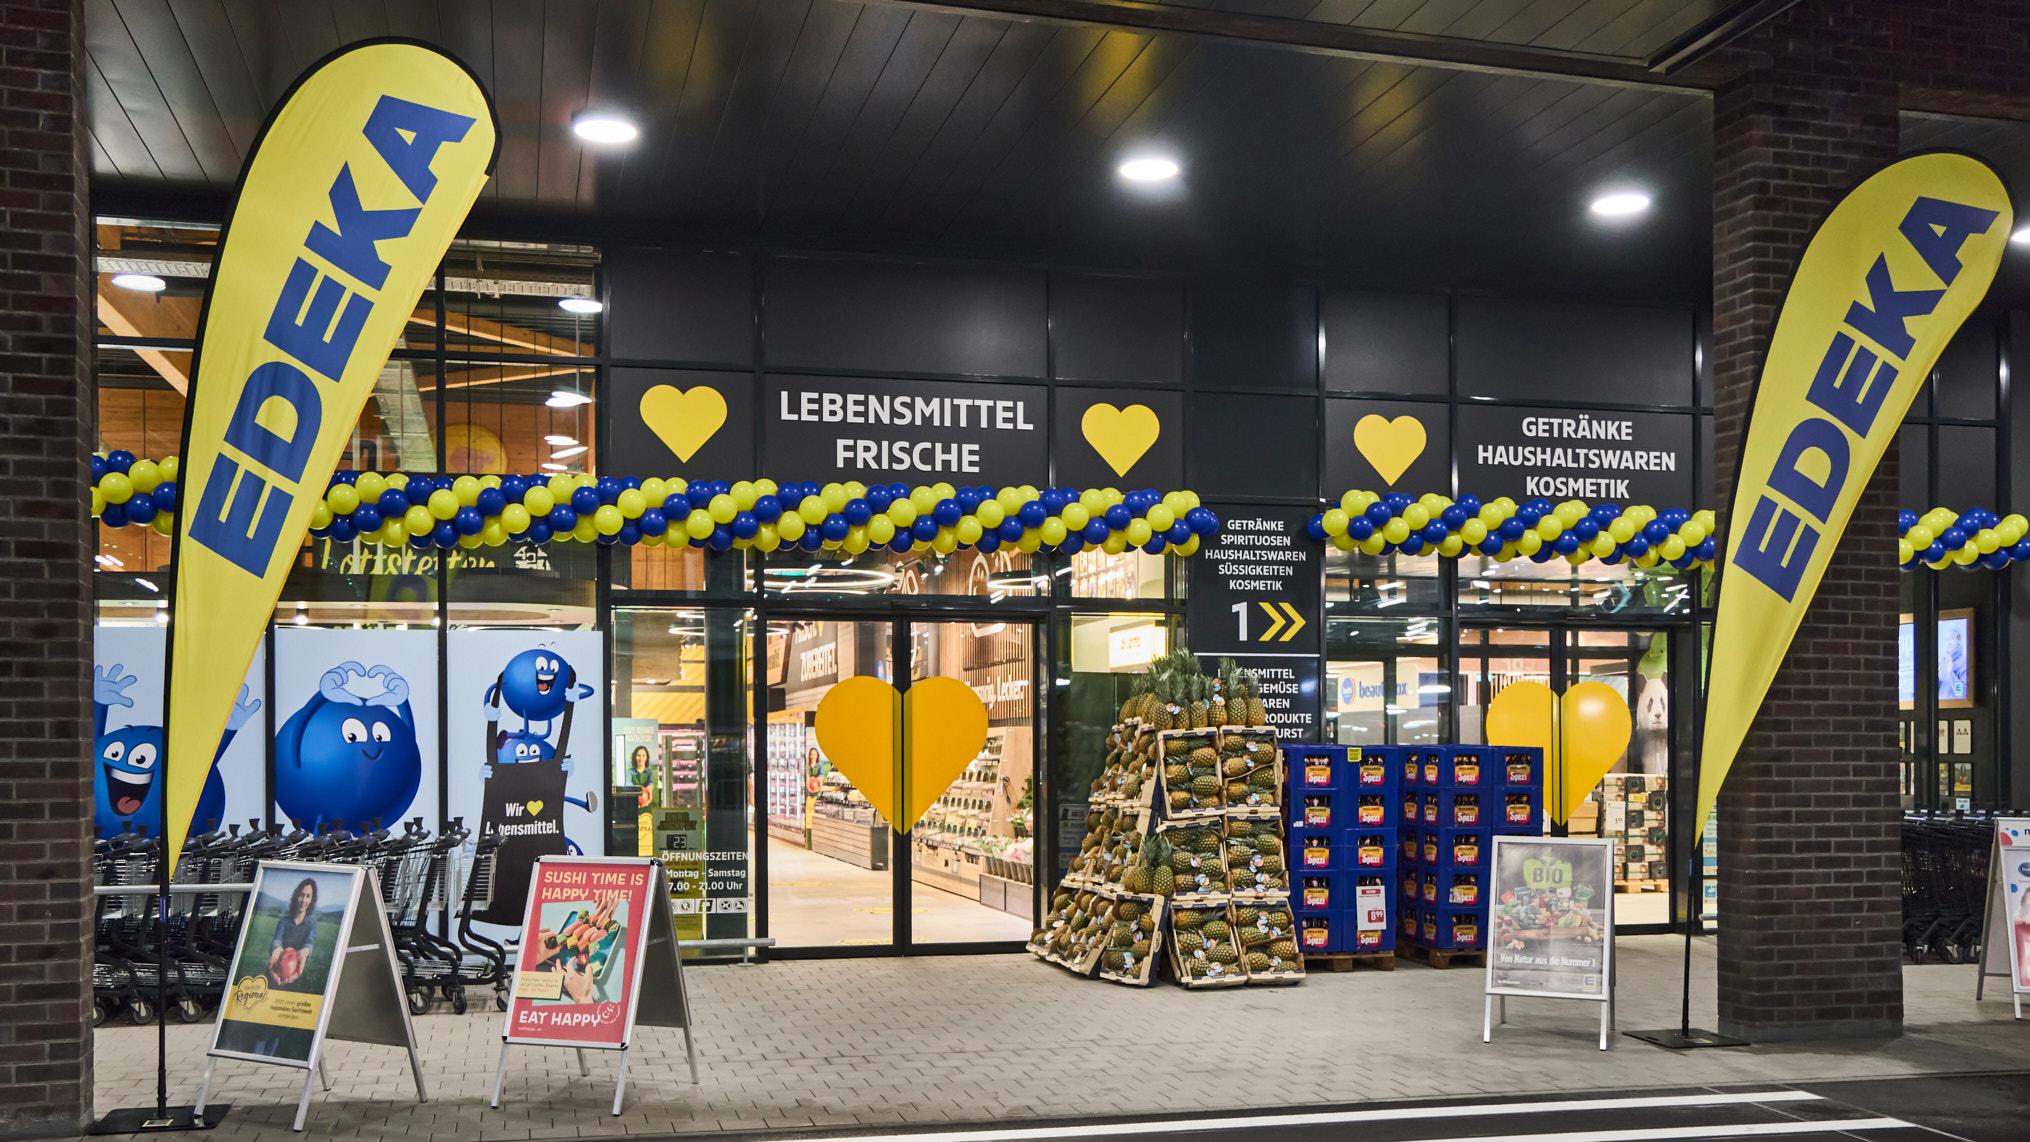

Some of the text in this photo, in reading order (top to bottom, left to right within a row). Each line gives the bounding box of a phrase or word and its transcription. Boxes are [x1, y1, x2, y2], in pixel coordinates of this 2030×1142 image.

[189, 95, 477, 578] EDEKA
[1733, 196, 2000, 603] EDEKA
[780, 390, 1034, 430] LEBENSMITTEL
[1521, 414, 1633, 441] GETRÄNKE
[836, 438, 980, 473] FRISCHE
[1477, 444, 1676, 472] HAUSHALTSWAREN
[1526, 476, 1630, 499] KOSMETIK
[1227, 518, 1285, 531] GETRÄNKE
[1220, 534, 1291, 546] SPIRITUOSEN
[1205, 548, 1307, 561] HAUSHALTSWAREN
[1218, 562, 1294, 576] SÜSSIGKEITEN
[1229, 579, 1283, 591] KOSMETIK
[1231, 601, 1248, 642] 1
[1260, 698, 1290, 709] AREN
[1264, 713, 1313, 724] RODUKTE
[1275, 728, 1304, 739] URST
[505, 802, 525, 817] Wir
[673, 835, 687, 848] 23
[661, 850, 749, 861] ÖFFNUNGSZEITEN
[543, 871, 645, 886] SUSHI TIME IS
[665, 869, 699, 879] Montag
[708, 868, 746, 878] Samstag
[1532, 867, 1564, 883] BIO
[668, 881, 690, 891] 7.00
[699, 881, 724, 891] 21.00
[726, 881, 744, 891] Uhr
[541, 887, 633, 902] HAPPY TIME!
[1501, 954, 1513, 964] Von
[1514, 954, 1533, 965] Natur
[1535, 956, 1547, 965] aus
[1561, 957, 1591, 968] Nummer
[519, 1010, 549, 1025] EAT
[550, 1012, 602, 1028] HAPPY
